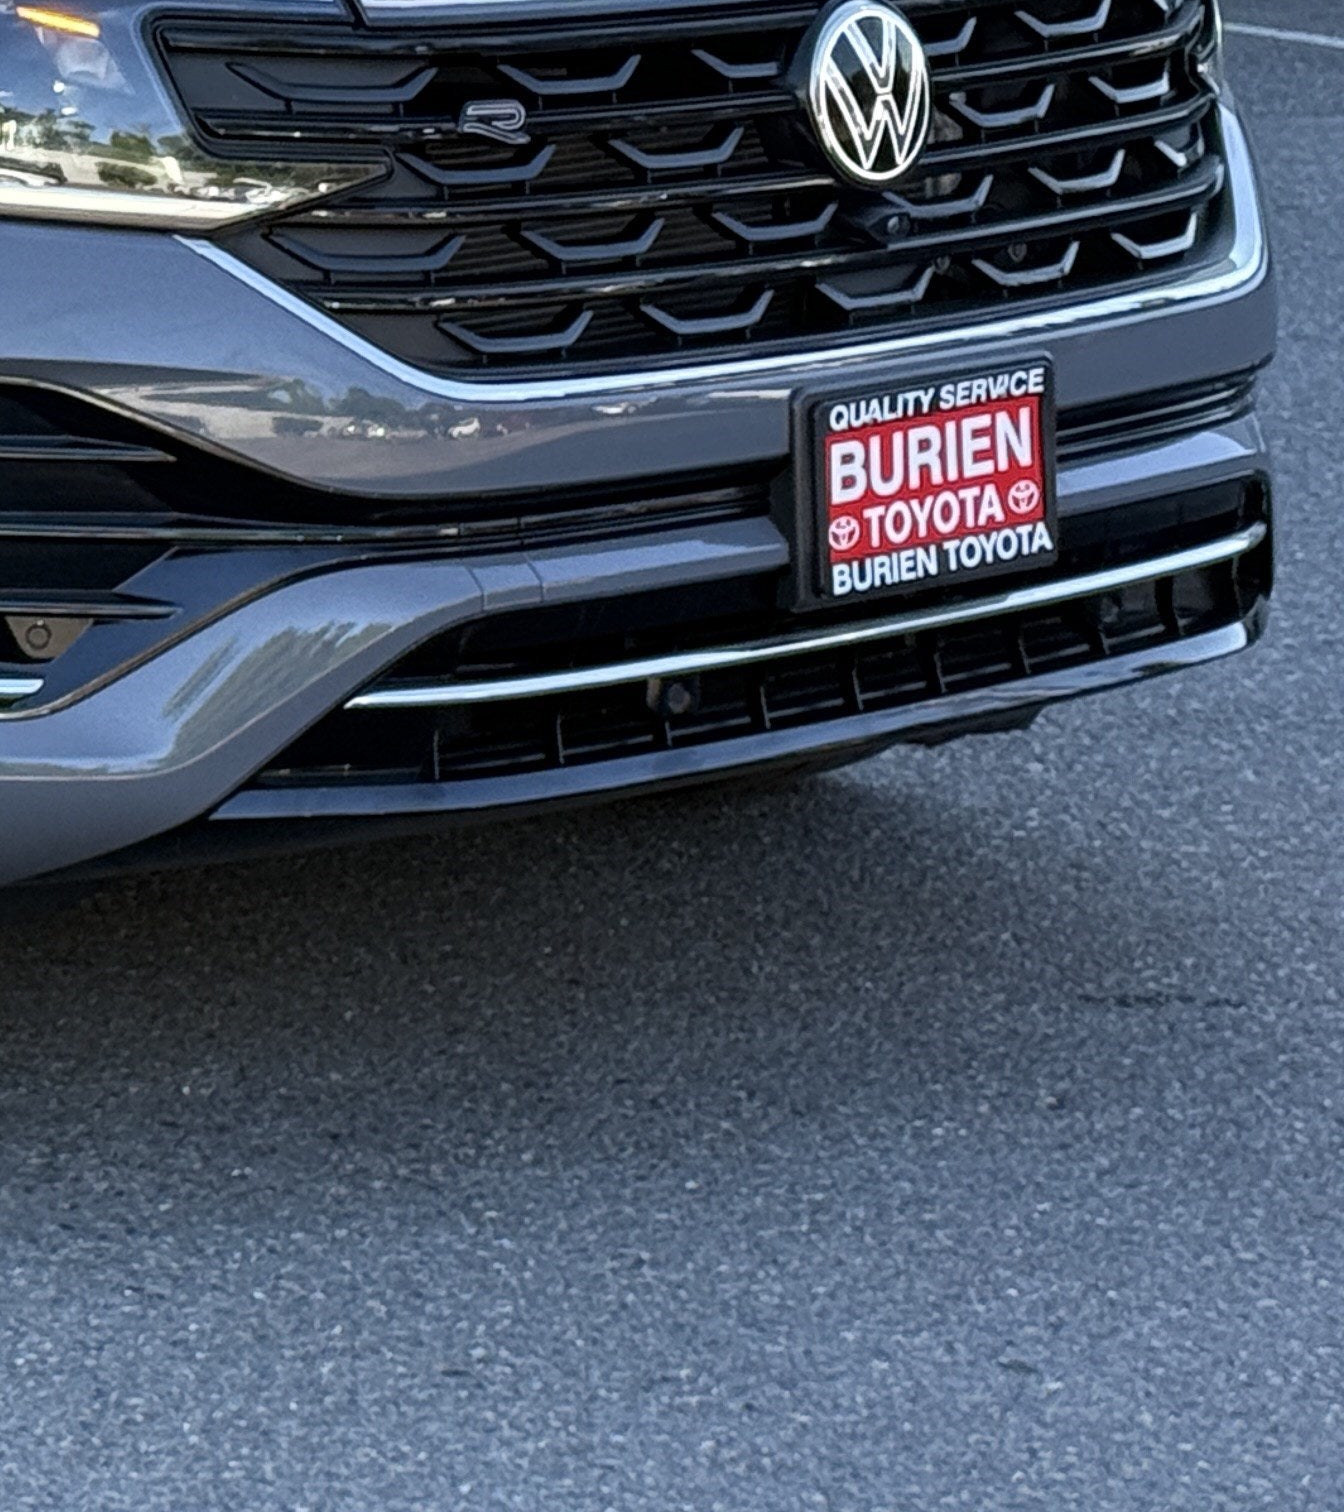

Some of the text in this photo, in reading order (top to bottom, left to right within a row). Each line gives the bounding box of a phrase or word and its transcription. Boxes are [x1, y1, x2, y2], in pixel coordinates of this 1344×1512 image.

[828, 367, 1045, 432] QUALITY SERVICE
[829, 406, 1033, 506] BURIEN
[862, 483, 1006, 549] TOYOTA
[831, 521, 1054, 596] BURIEN TOYOTA
